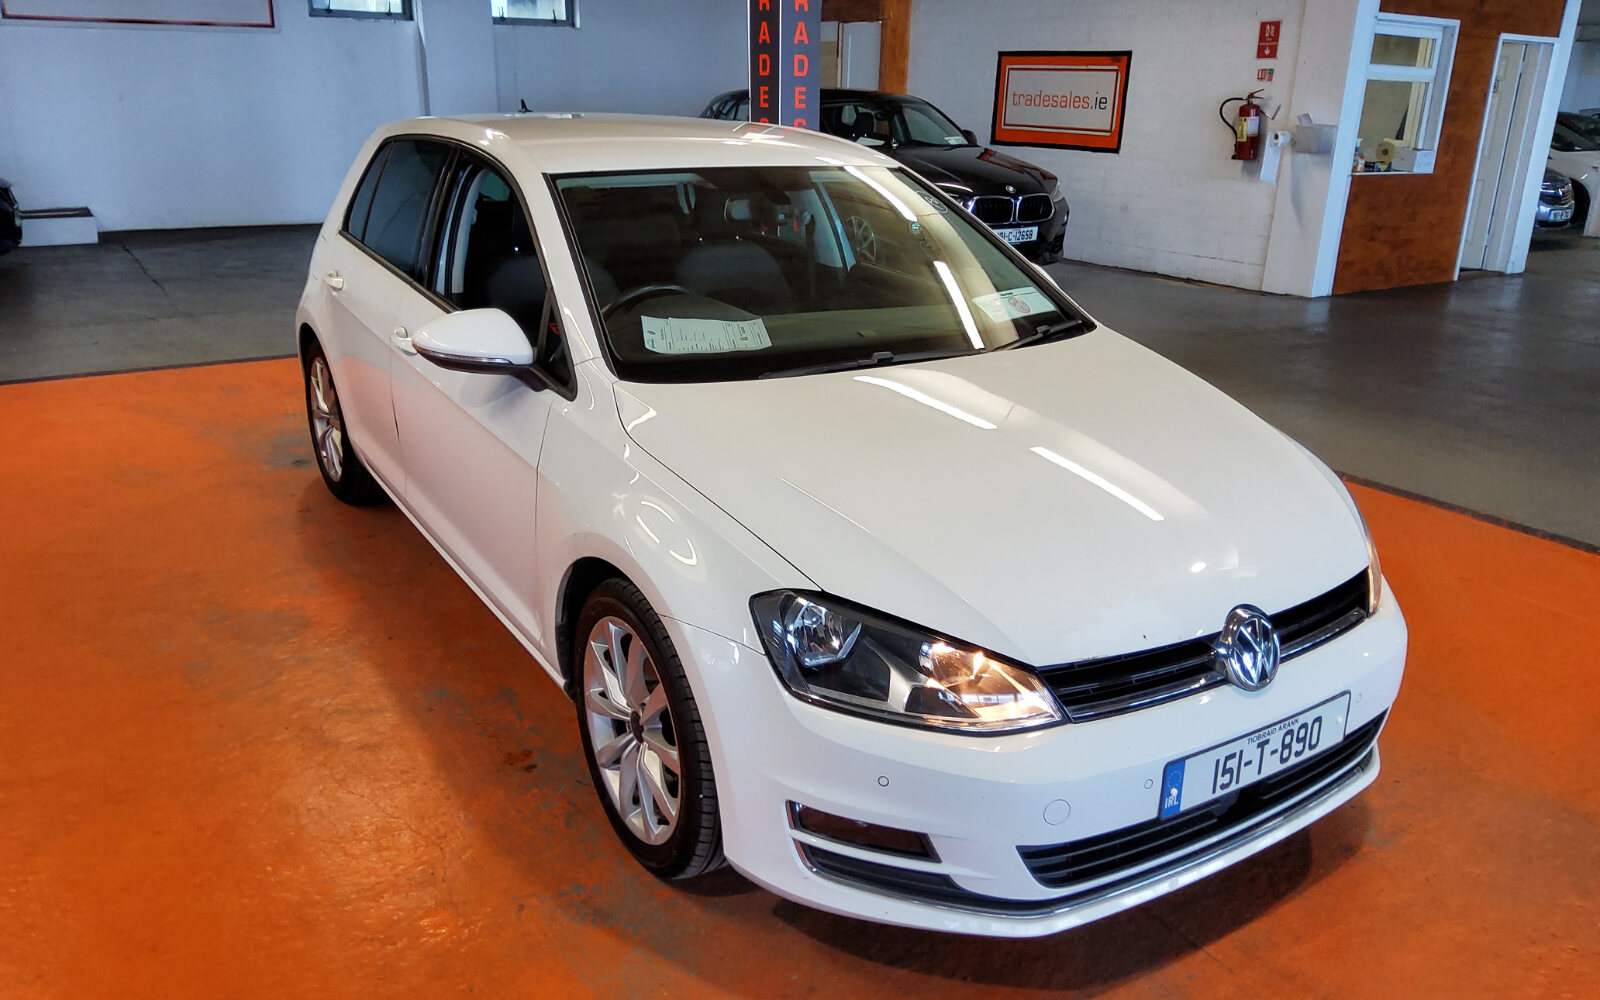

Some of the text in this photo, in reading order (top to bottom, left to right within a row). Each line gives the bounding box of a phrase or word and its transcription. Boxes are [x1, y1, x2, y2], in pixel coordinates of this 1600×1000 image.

[1012, 90, 1108, 110] tradesales.ie
[1247, 717, 1300, 745] TIOBRAID ARANN
[1212, 715, 1323, 794] 151-T-890
[1164, 795, 1179, 809] IRL
